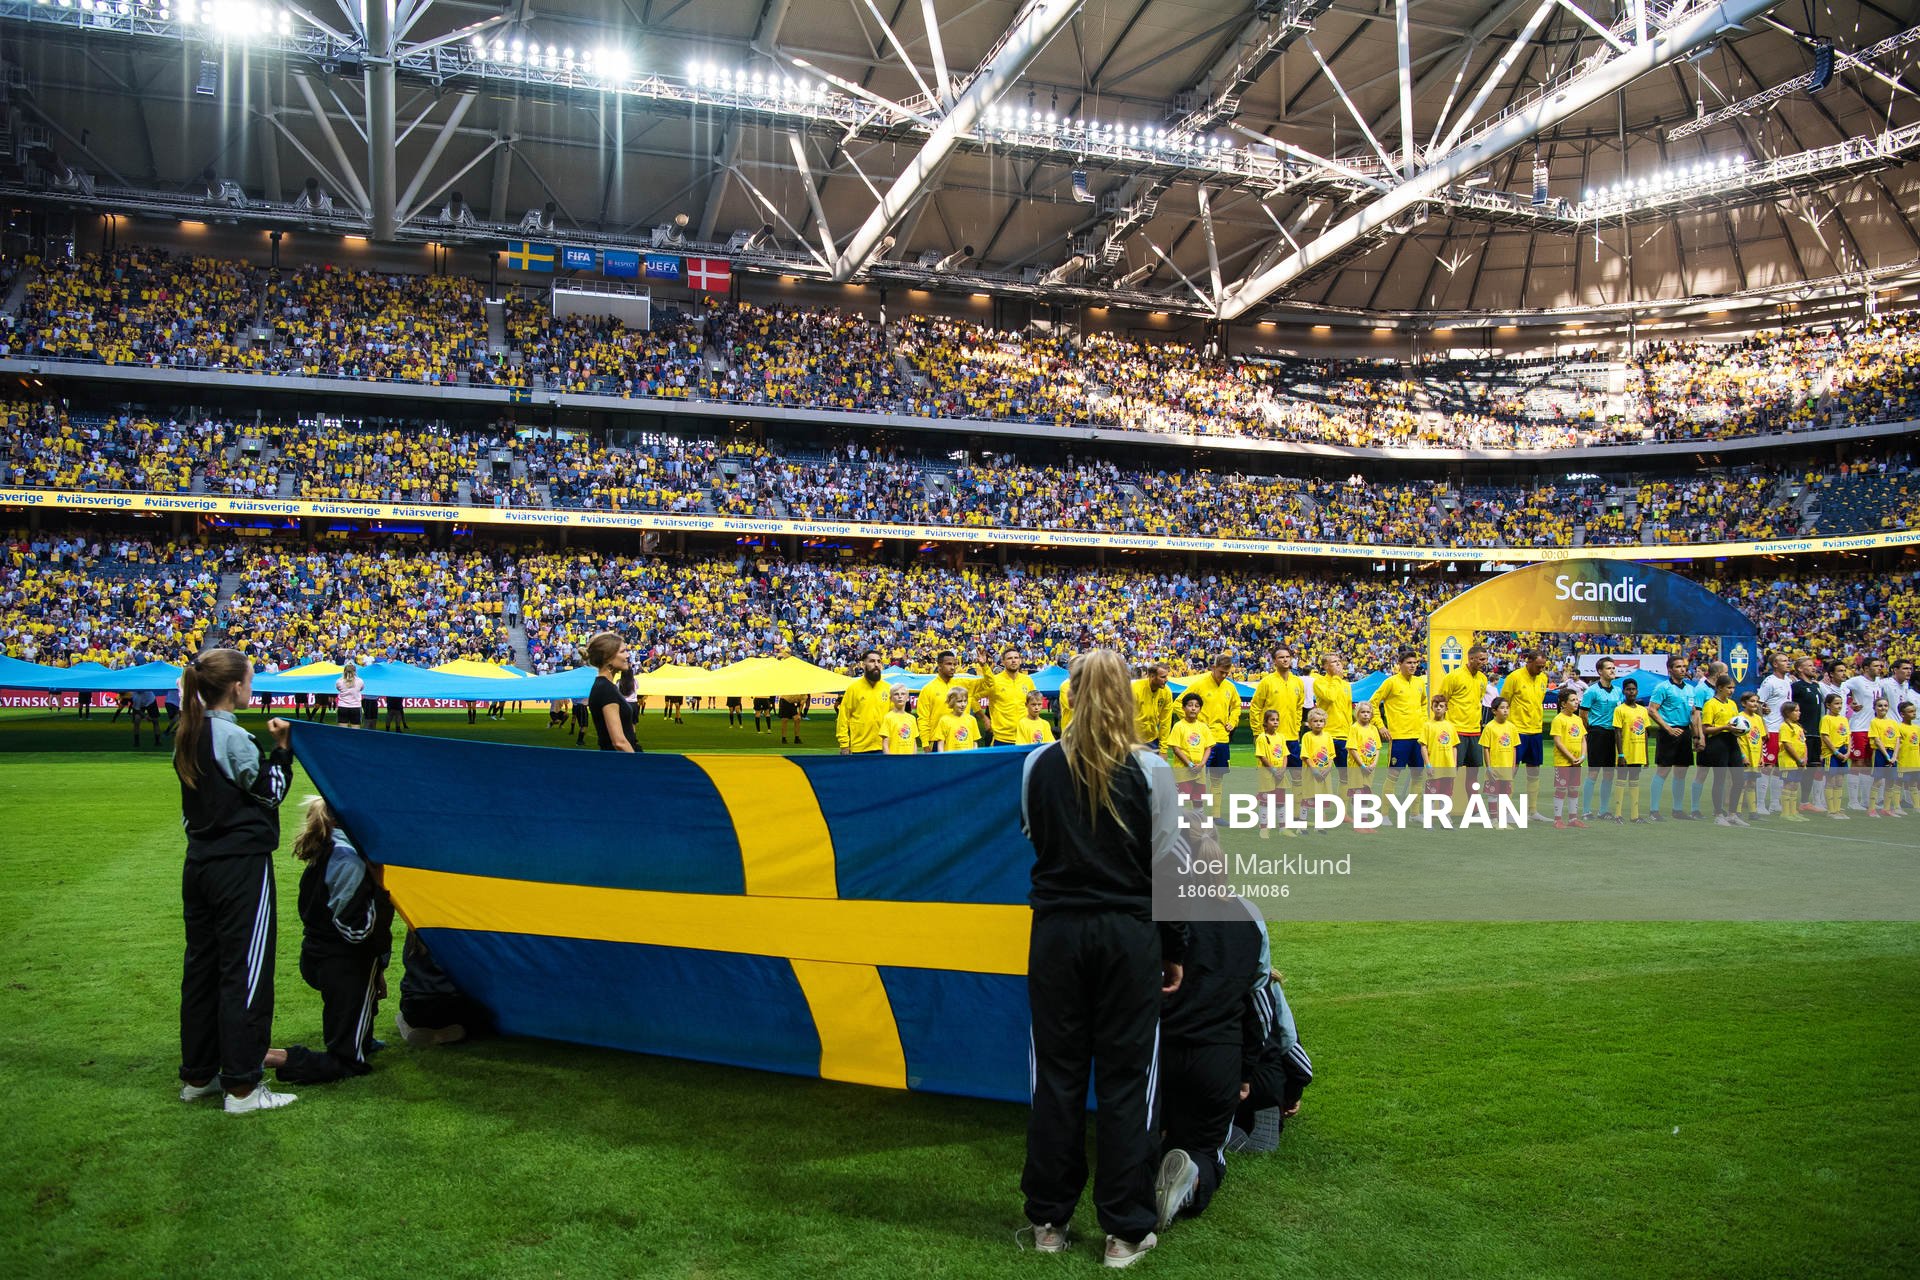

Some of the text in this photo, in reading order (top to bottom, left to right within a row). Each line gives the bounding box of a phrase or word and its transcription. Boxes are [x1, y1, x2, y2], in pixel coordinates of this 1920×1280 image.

[567, 251, 591, 262] FIFA
[647, 261, 678, 273] UEFA
[56, 494, 131, 508] #viärsverige
[144, 497, 217, 511] #viärsverige
[229, 501, 300, 514] #viärsverige
[311, 504, 381, 517] #viärsverige
[391, 507, 459, 519] #viärsverige
[505, 511, 569, 524] #viärsverige
[580, 515, 643, 527] #viärsverige
[652, 517, 714, 529] #viärsverige
[724, 521, 782, 532] #viärsverige
[792, 523, 850, 535] #viärsverige
[860, 527, 916, 537] #viärsverige
[924, 529, 978, 540] #viärsverige
[1541, 550, 1569, 559] 00:00
[1555, 575, 1647, 603] Scandic
[63, 697, 97, 707] SPL
[434, 698, 464, 708] SPEL
